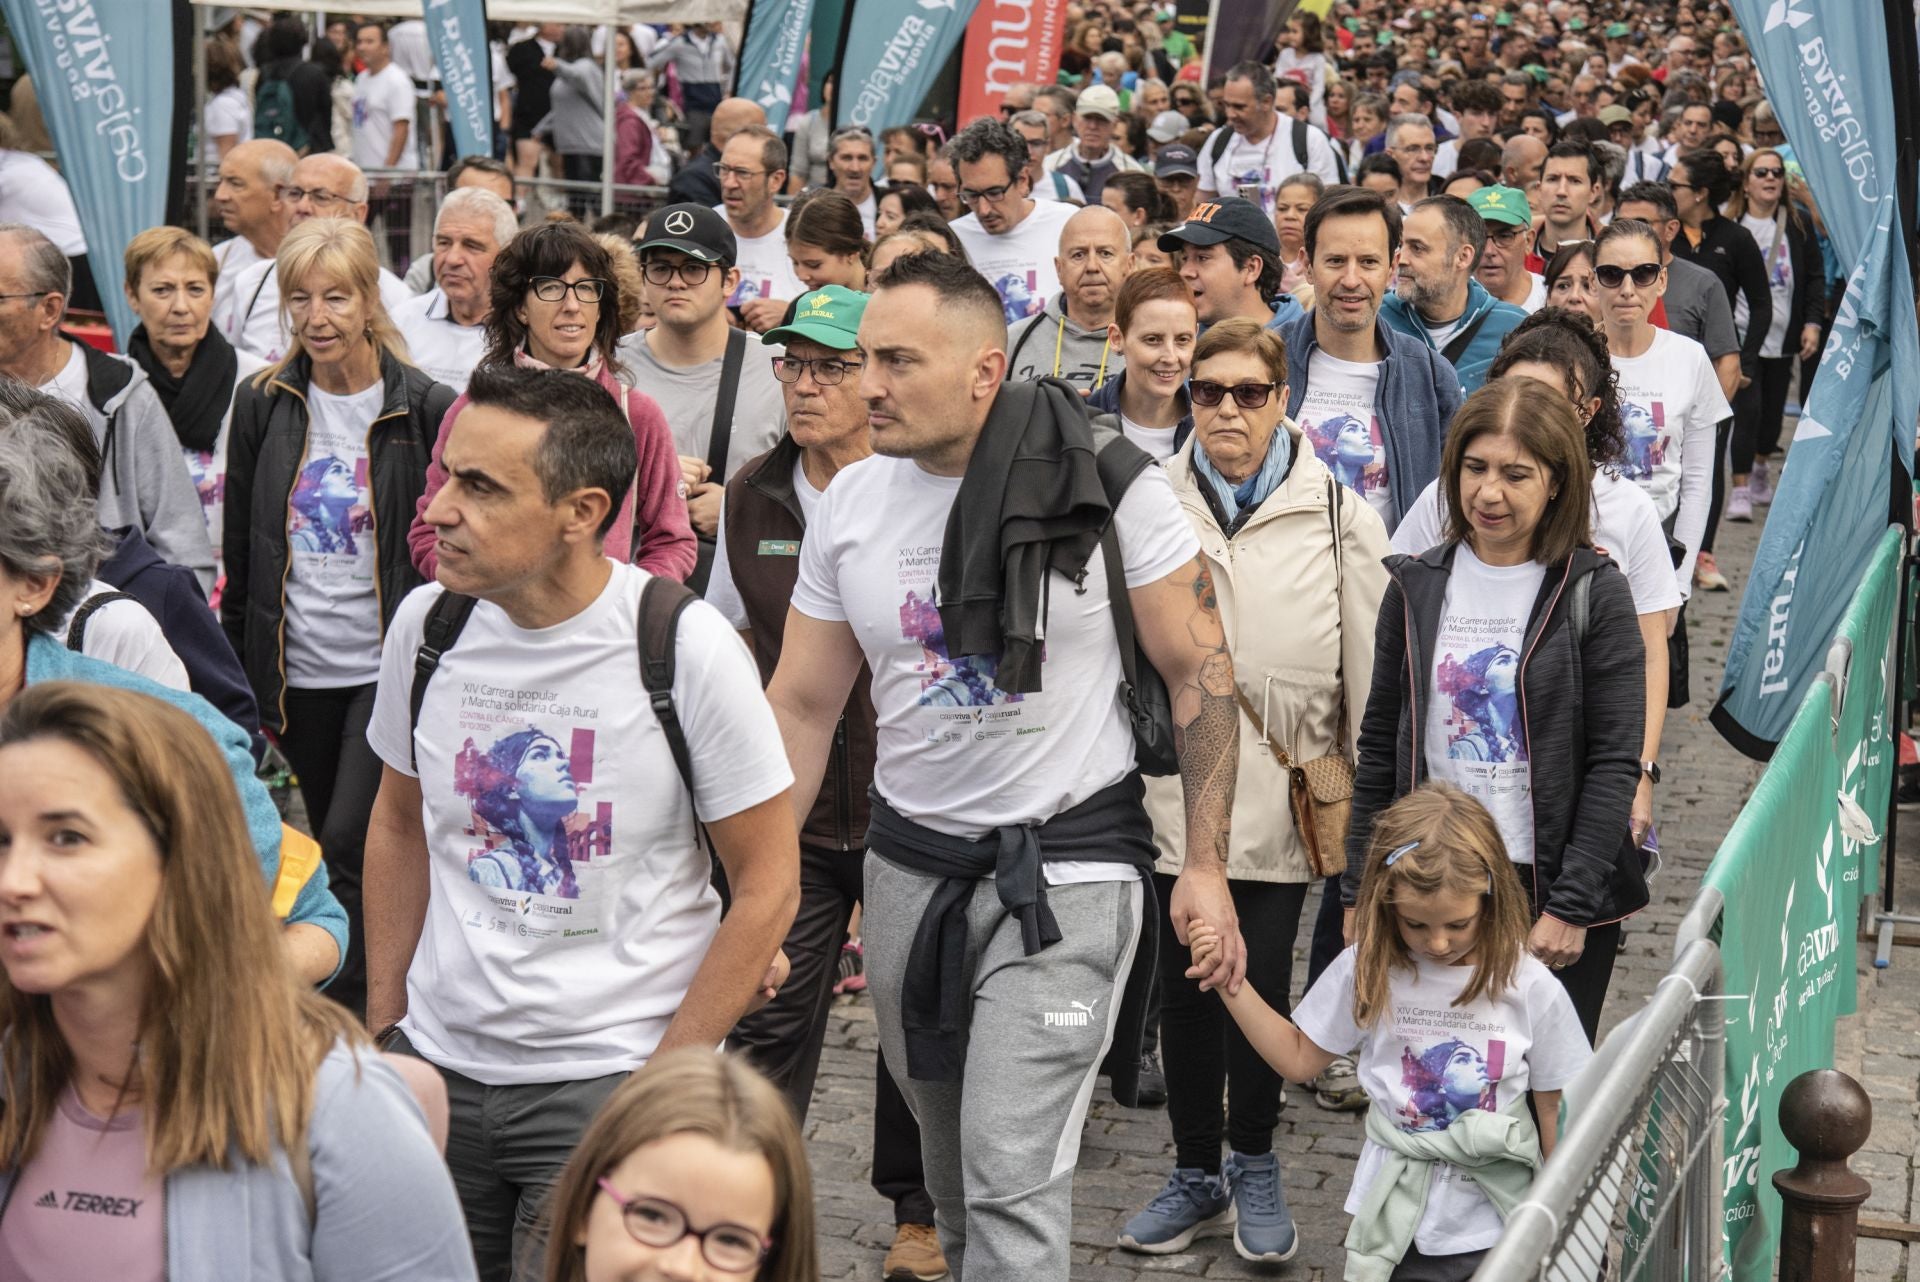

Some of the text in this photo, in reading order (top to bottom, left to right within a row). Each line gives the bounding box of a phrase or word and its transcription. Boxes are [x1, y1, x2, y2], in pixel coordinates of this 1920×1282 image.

[851, 15, 925, 126] cajaviva
[899, 546, 941, 557] XIV Carre
[898, 557, 940, 569] y Marcha
[1444, 616, 1517, 626] XIV Carrera popular
[1448, 624, 1477, 634] Marcha
[1479, 625, 1508, 634] solidaria
[1760, 543, 1804, 699] rural
[463, 682, 558, 701] XIV Carrera popular
[459, 710, 485, 720] CONTRA
[461, 697, 599, 719] y Marcha solidaria Caja Rural
[1044, 1012, 1088, 1026] PUMA
[1396, 1006, 1475, 1021] XIV Carrera popular
[1402, 1016, 1432, 1026] Marcha
[1433, 1018, 1466, 1029] solidaria
[1468, 1021, 1486, 1033] Caja
[63, 1191, 144, 1218] TERREX
[1724, 1200, 1756, 1222] ción
